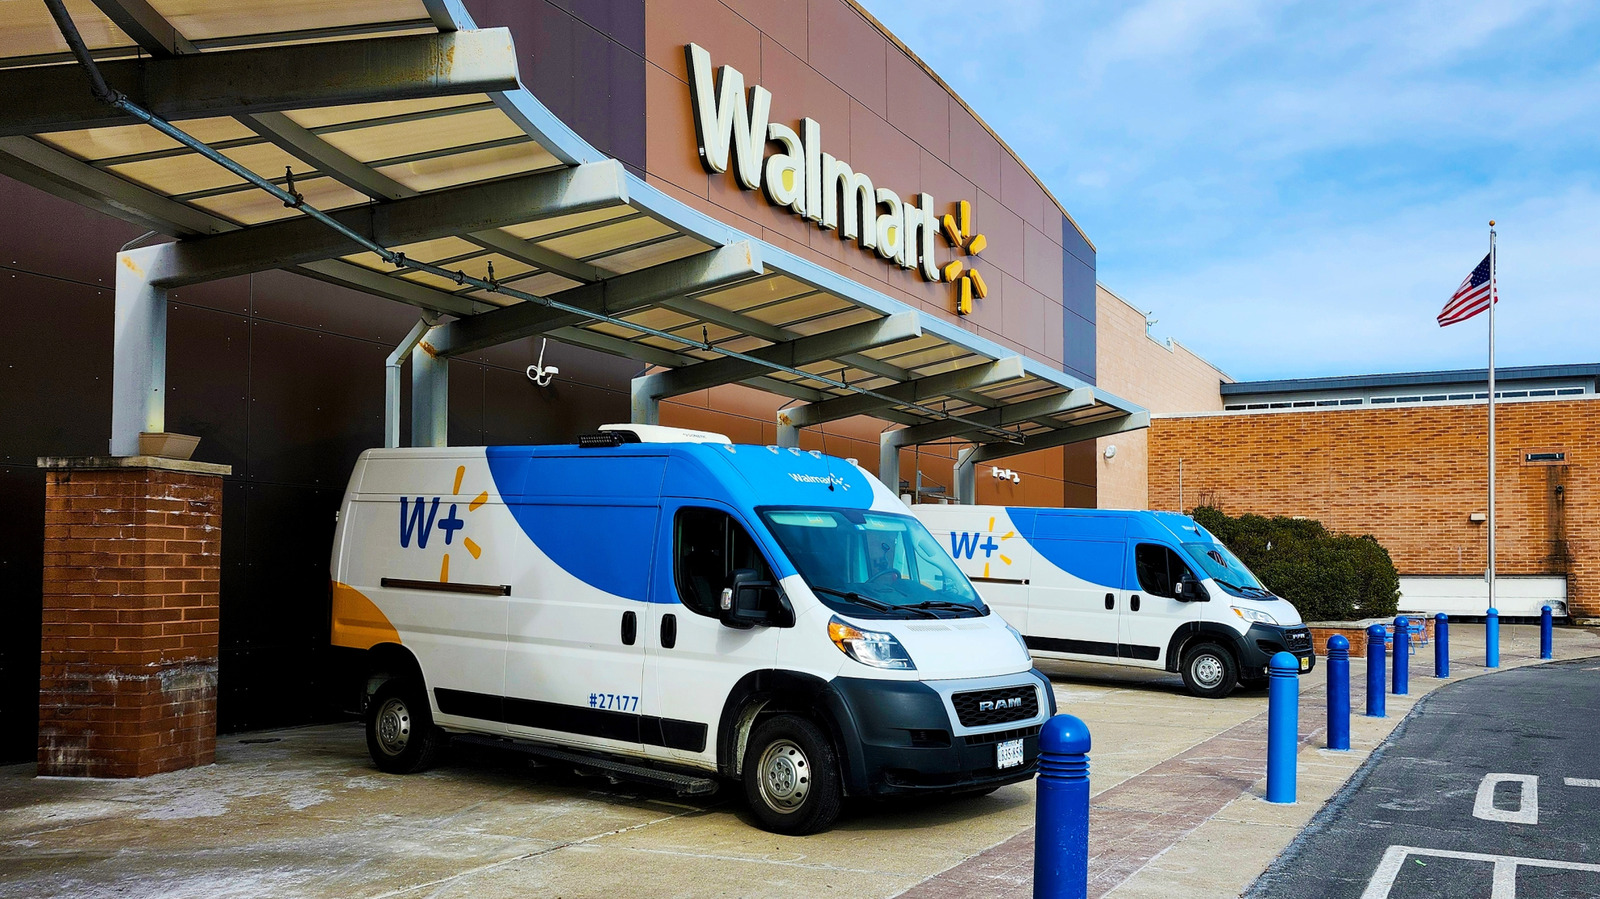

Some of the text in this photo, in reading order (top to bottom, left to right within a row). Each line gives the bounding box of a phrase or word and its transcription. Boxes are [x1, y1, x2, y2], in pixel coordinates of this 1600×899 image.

[684, 42, 940, 282] Walmart
[589, 692, 639, 712] #27177
[979, 697, 1022, 712] RAM
